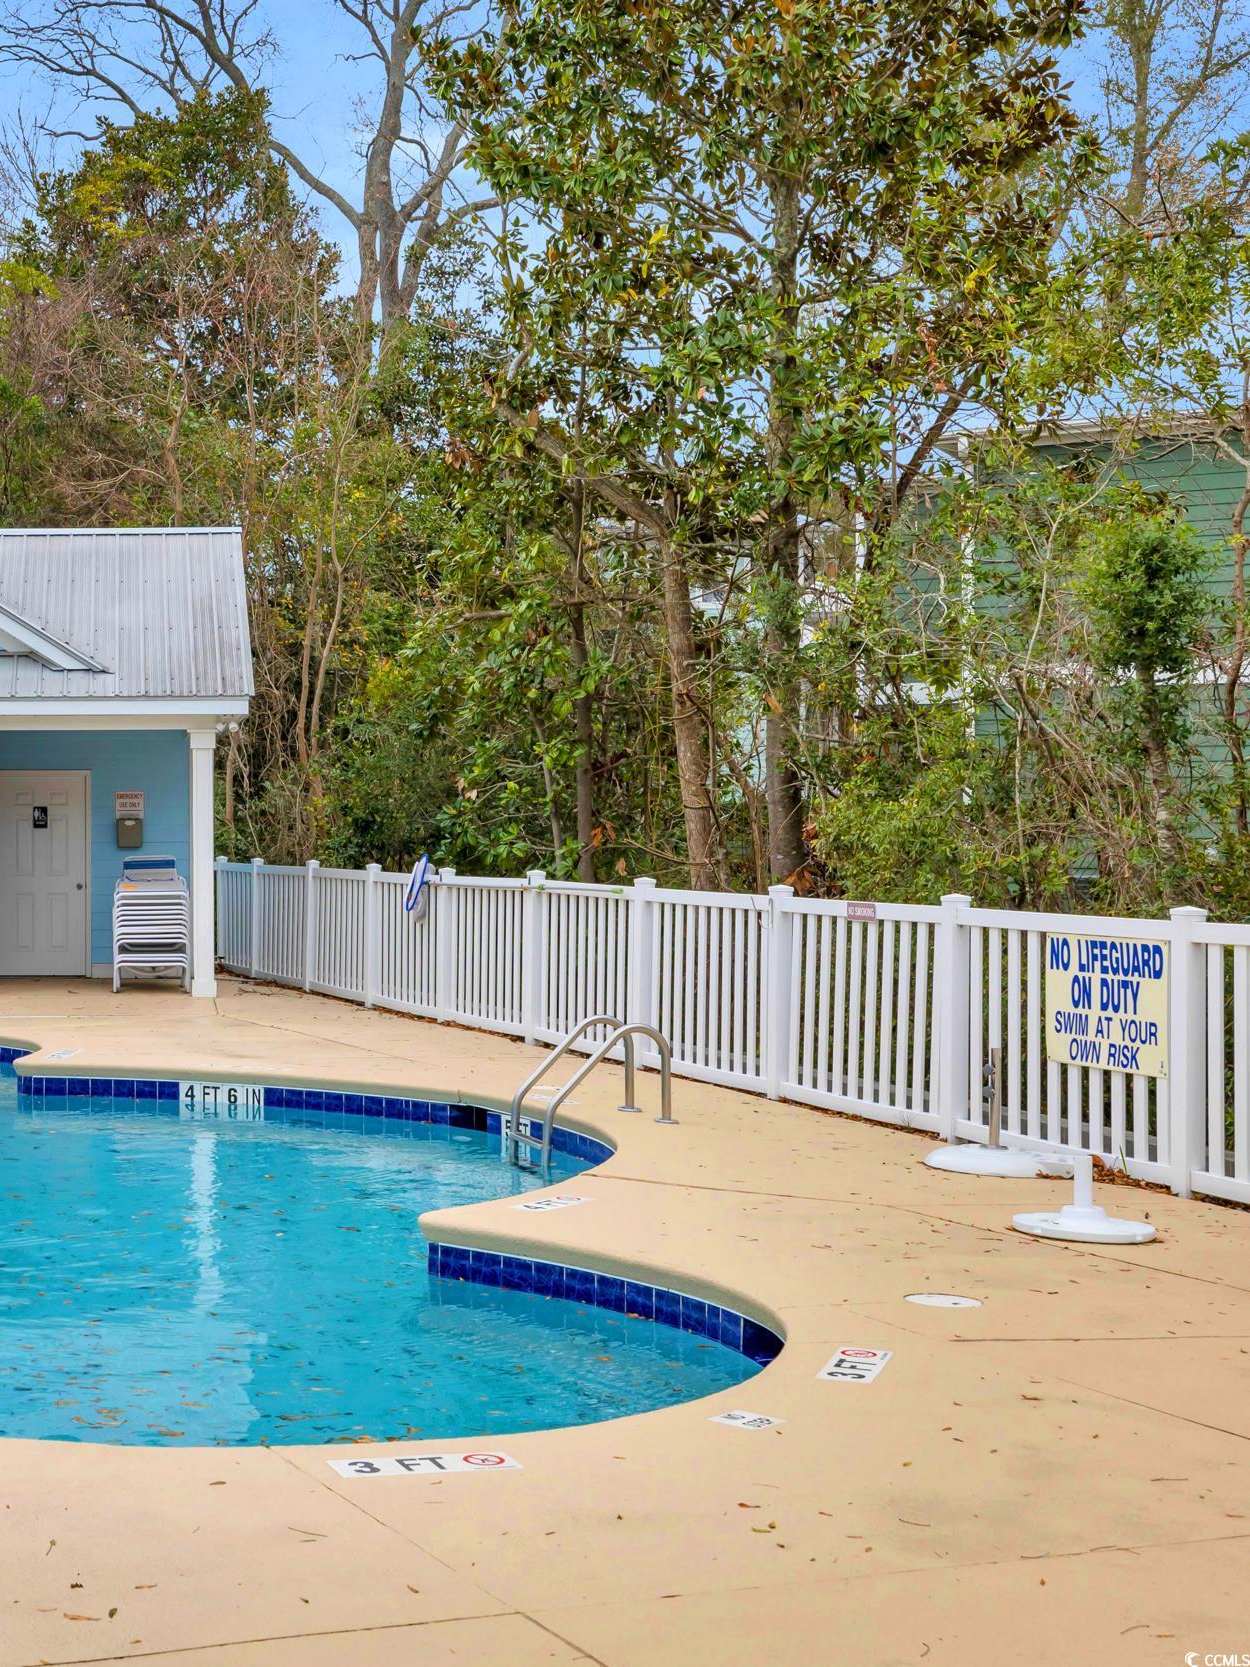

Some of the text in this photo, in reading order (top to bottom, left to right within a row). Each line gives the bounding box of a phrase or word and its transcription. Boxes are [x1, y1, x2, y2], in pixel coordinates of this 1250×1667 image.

[847, 906, 854, 916] NO
[1050, 937, 1164, 980] NO LIFEGUARD
[1071, 974, 1140, 1015] ON DUTY
[1054, 1010, 1158, 1046] SWIM AT YOUR
[1069, 1038, 1140, 1070] OWN RISK
[185, 1085, 261, 1106] 4 FT 6 IN
[827, 1358, 877, 1379] 3 FT
[348, 1456, 447, 1474] 3 FT
